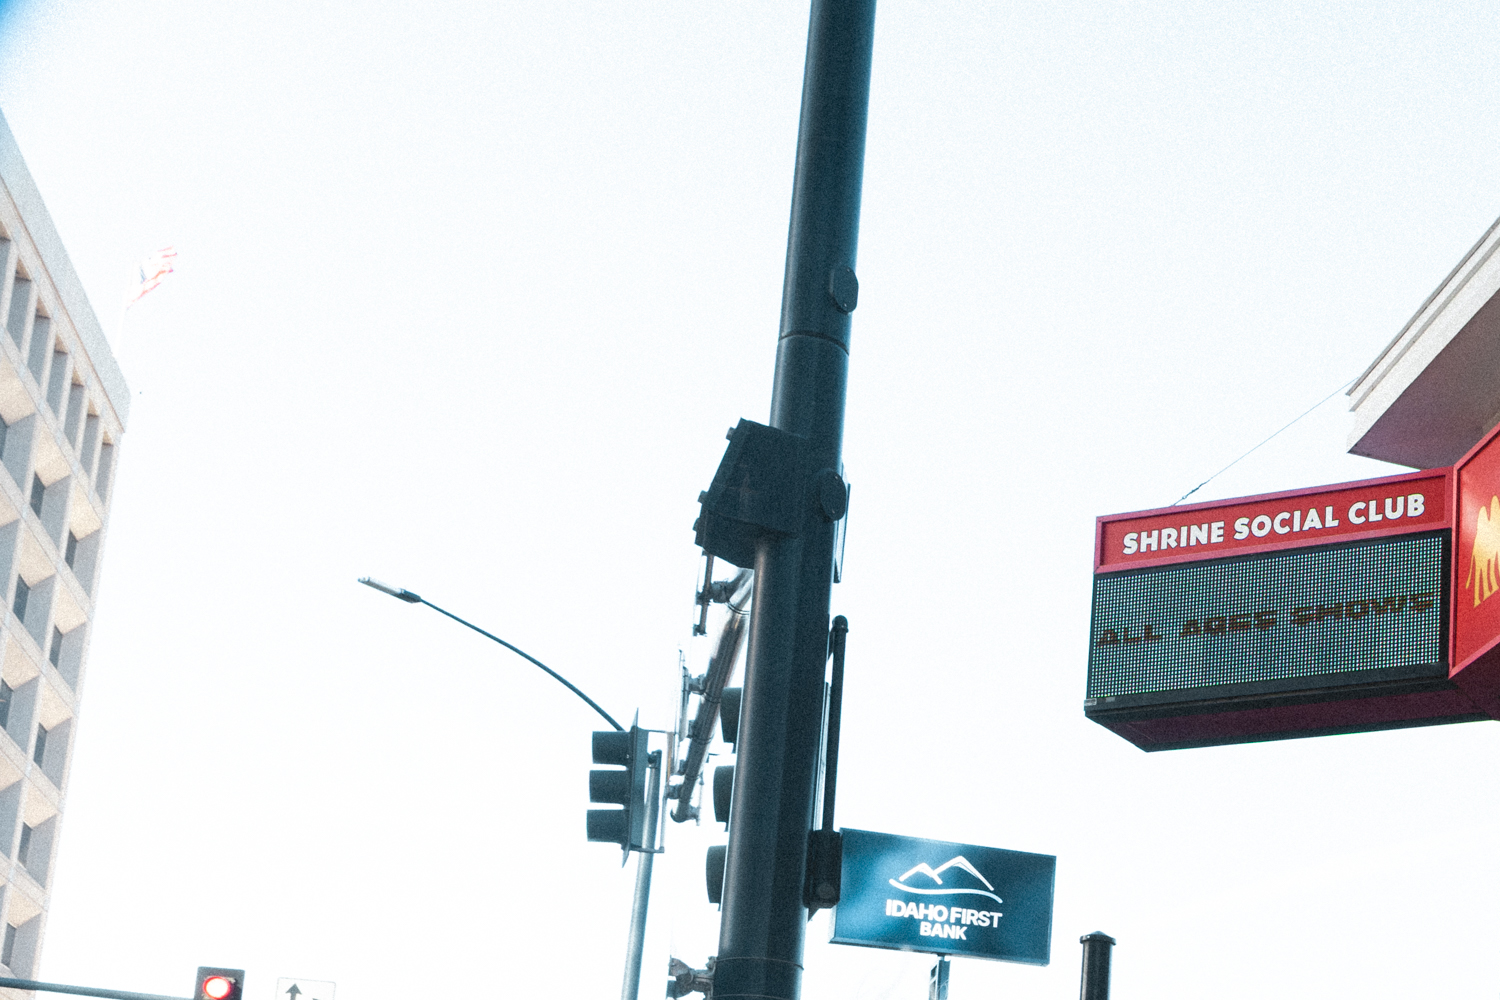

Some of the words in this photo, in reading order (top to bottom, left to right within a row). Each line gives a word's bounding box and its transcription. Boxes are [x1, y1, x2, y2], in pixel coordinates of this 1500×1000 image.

[1122, 520, 1226, 555] SHRINE
[1233, 505, 1340, 540] SOCIAL
[1347, 493, 1426, 525] CLUB
[1096, 623, 1163, 647] ALL
[1180, 609, 1278, 637] AGES
[1290, 592, 1435, 626] SHOWS
[885, 898, 949, 922] IDAHO
[950, 907, 1003, 928] FIRST
[919, 921, 968, 940] BANK
